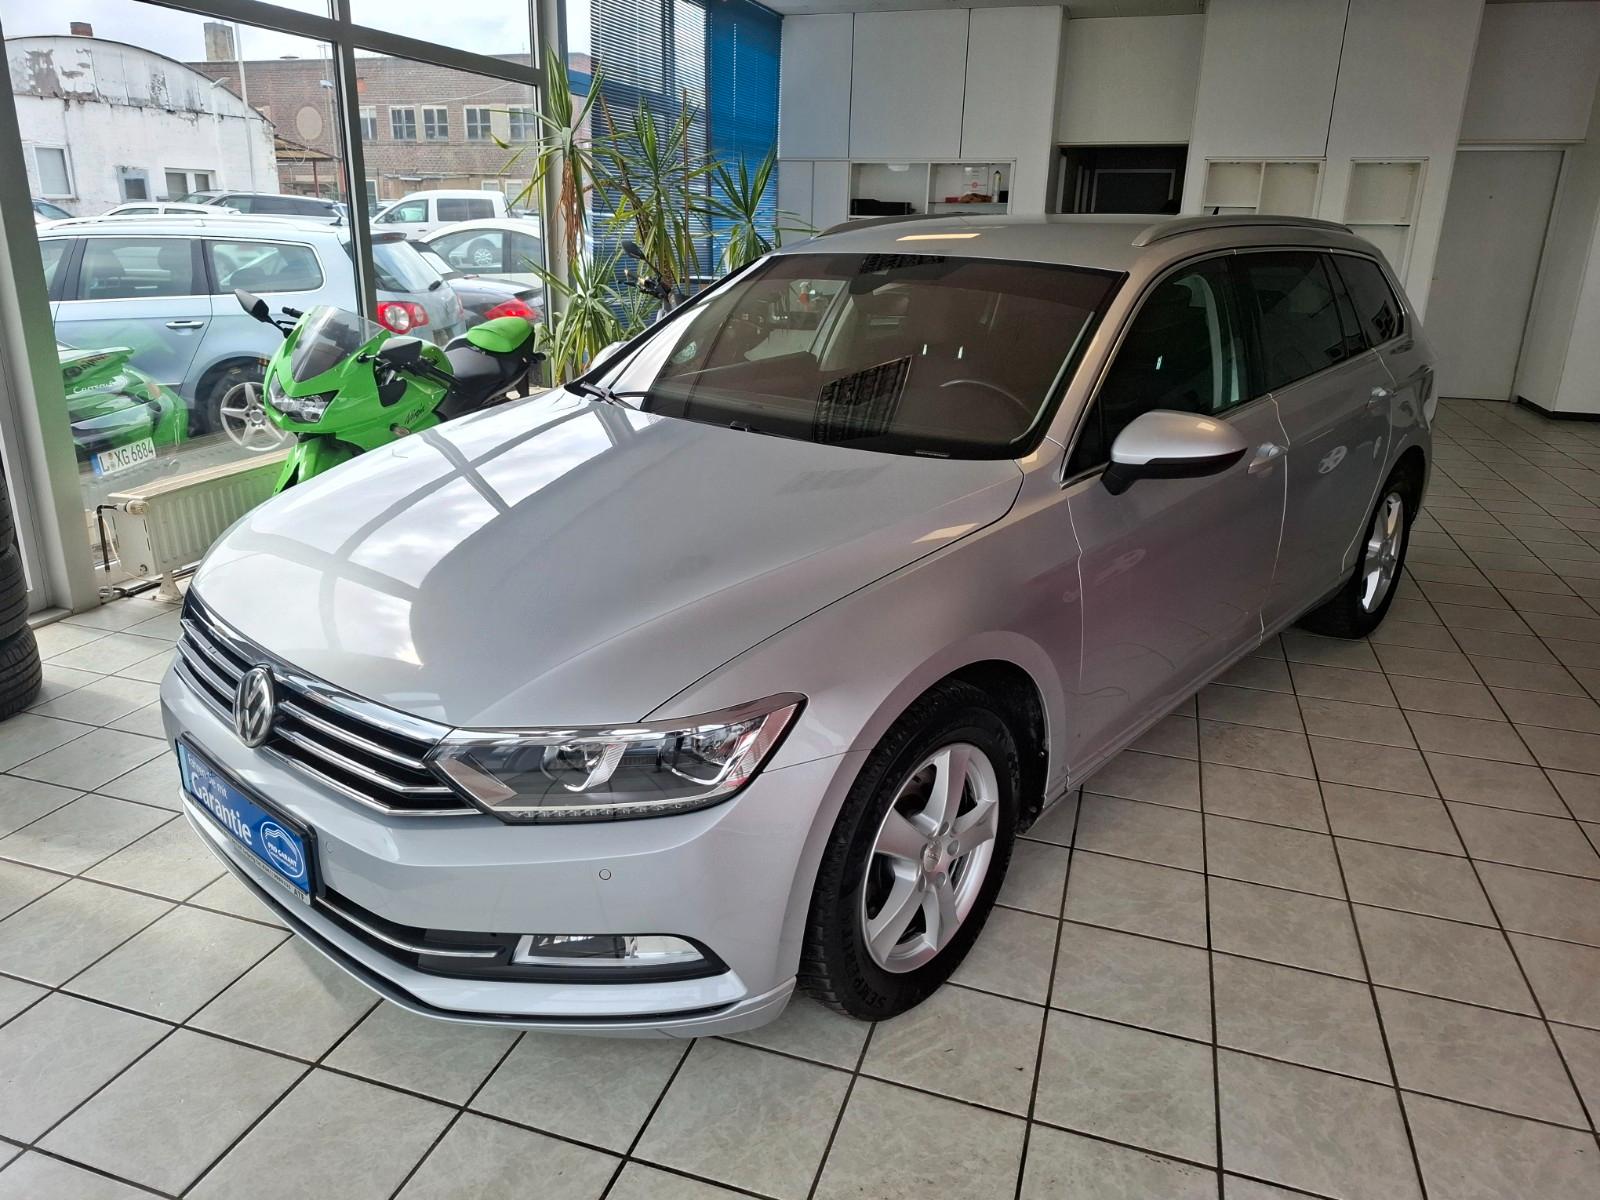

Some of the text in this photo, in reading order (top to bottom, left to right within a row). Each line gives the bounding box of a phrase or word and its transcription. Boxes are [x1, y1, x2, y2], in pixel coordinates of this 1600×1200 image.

[98, 441, 154, 472] L XG 6884
[191, 771, 253, 846] Garantie
